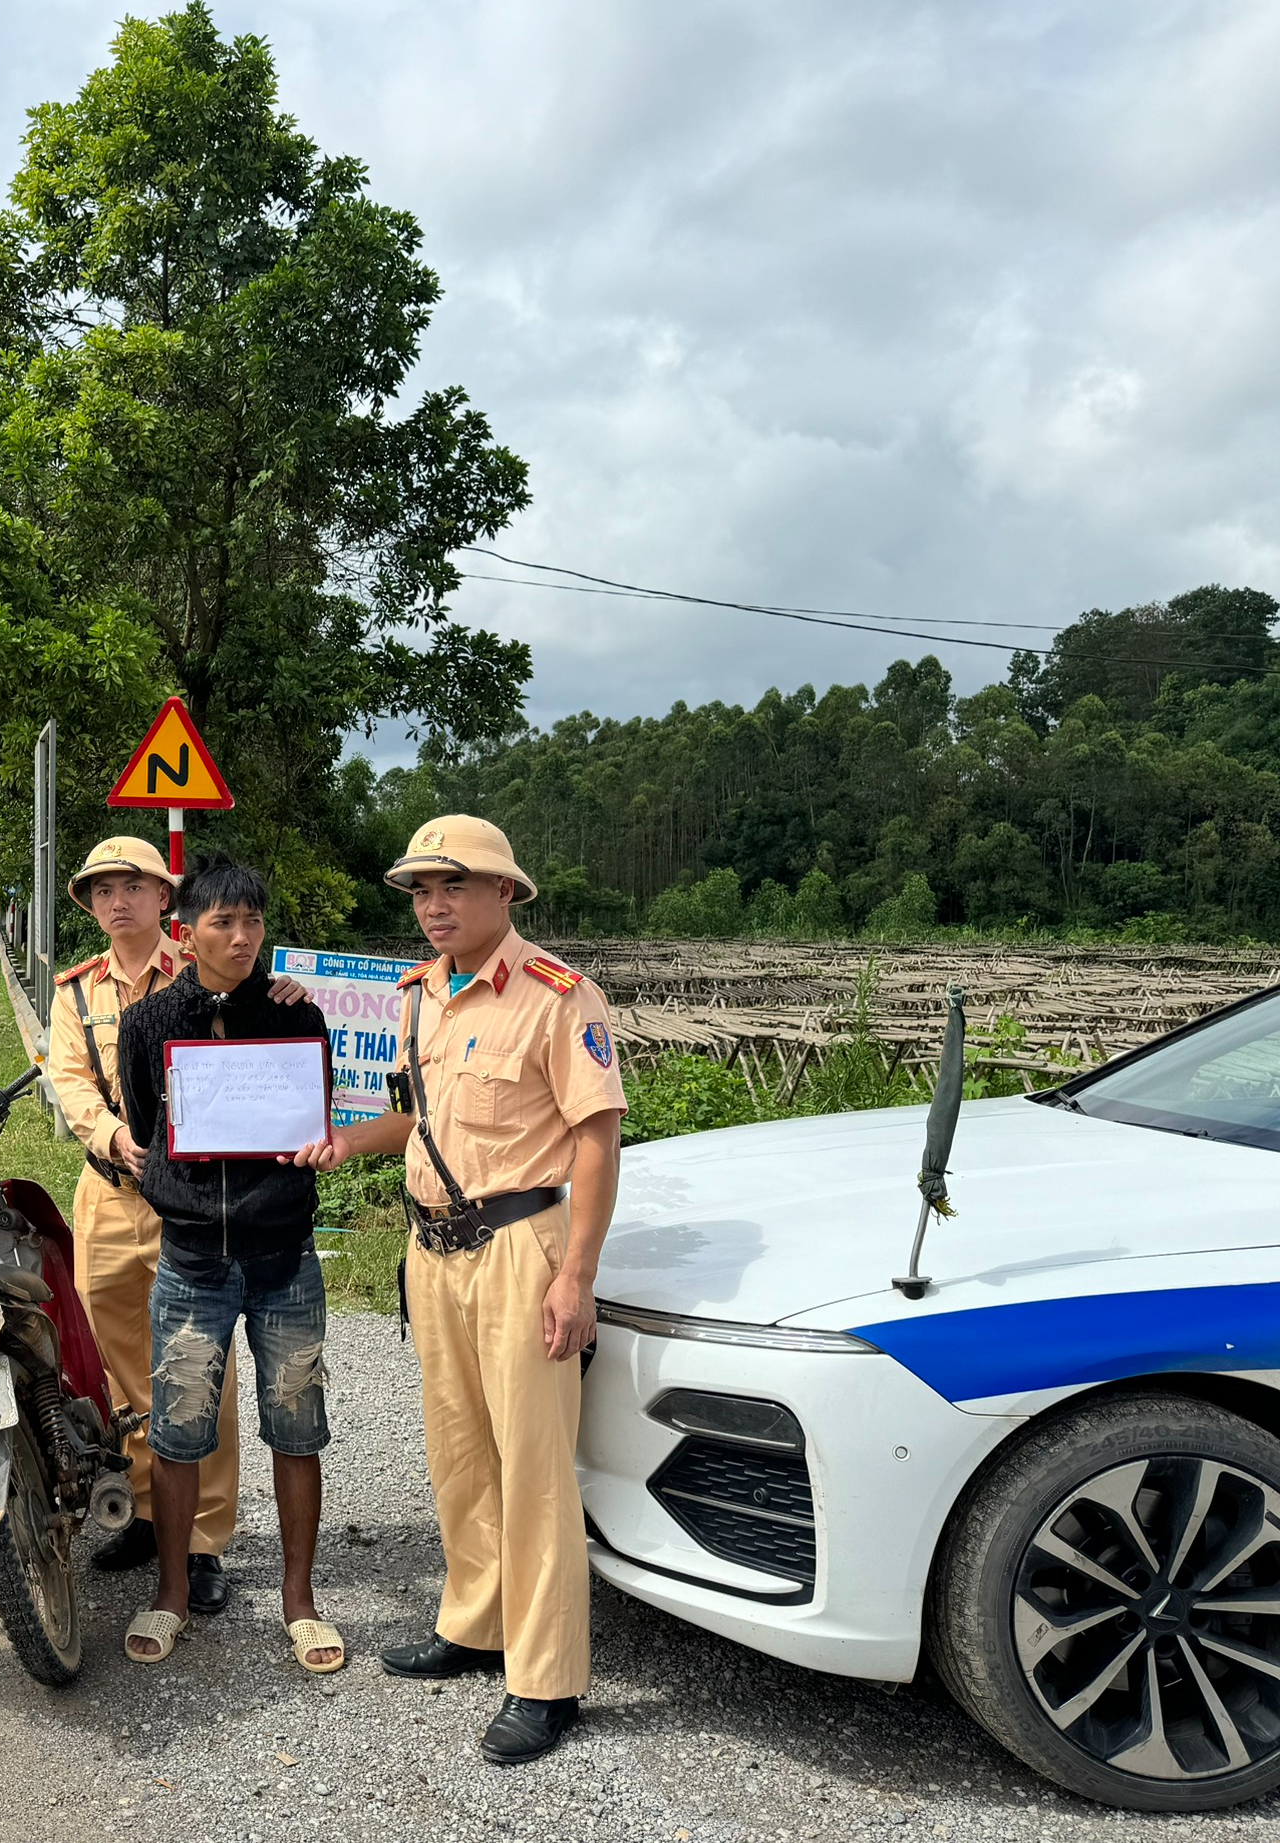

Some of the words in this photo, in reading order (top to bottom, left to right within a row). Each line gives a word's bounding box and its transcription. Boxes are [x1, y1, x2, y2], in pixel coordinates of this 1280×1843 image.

[323, 957, 344, 969] CÔNG
[346, 961, 356, 969] TY
[308, 982, 401, 1022] HÔNG
[364, 1071, 383, 1095] TẠI
